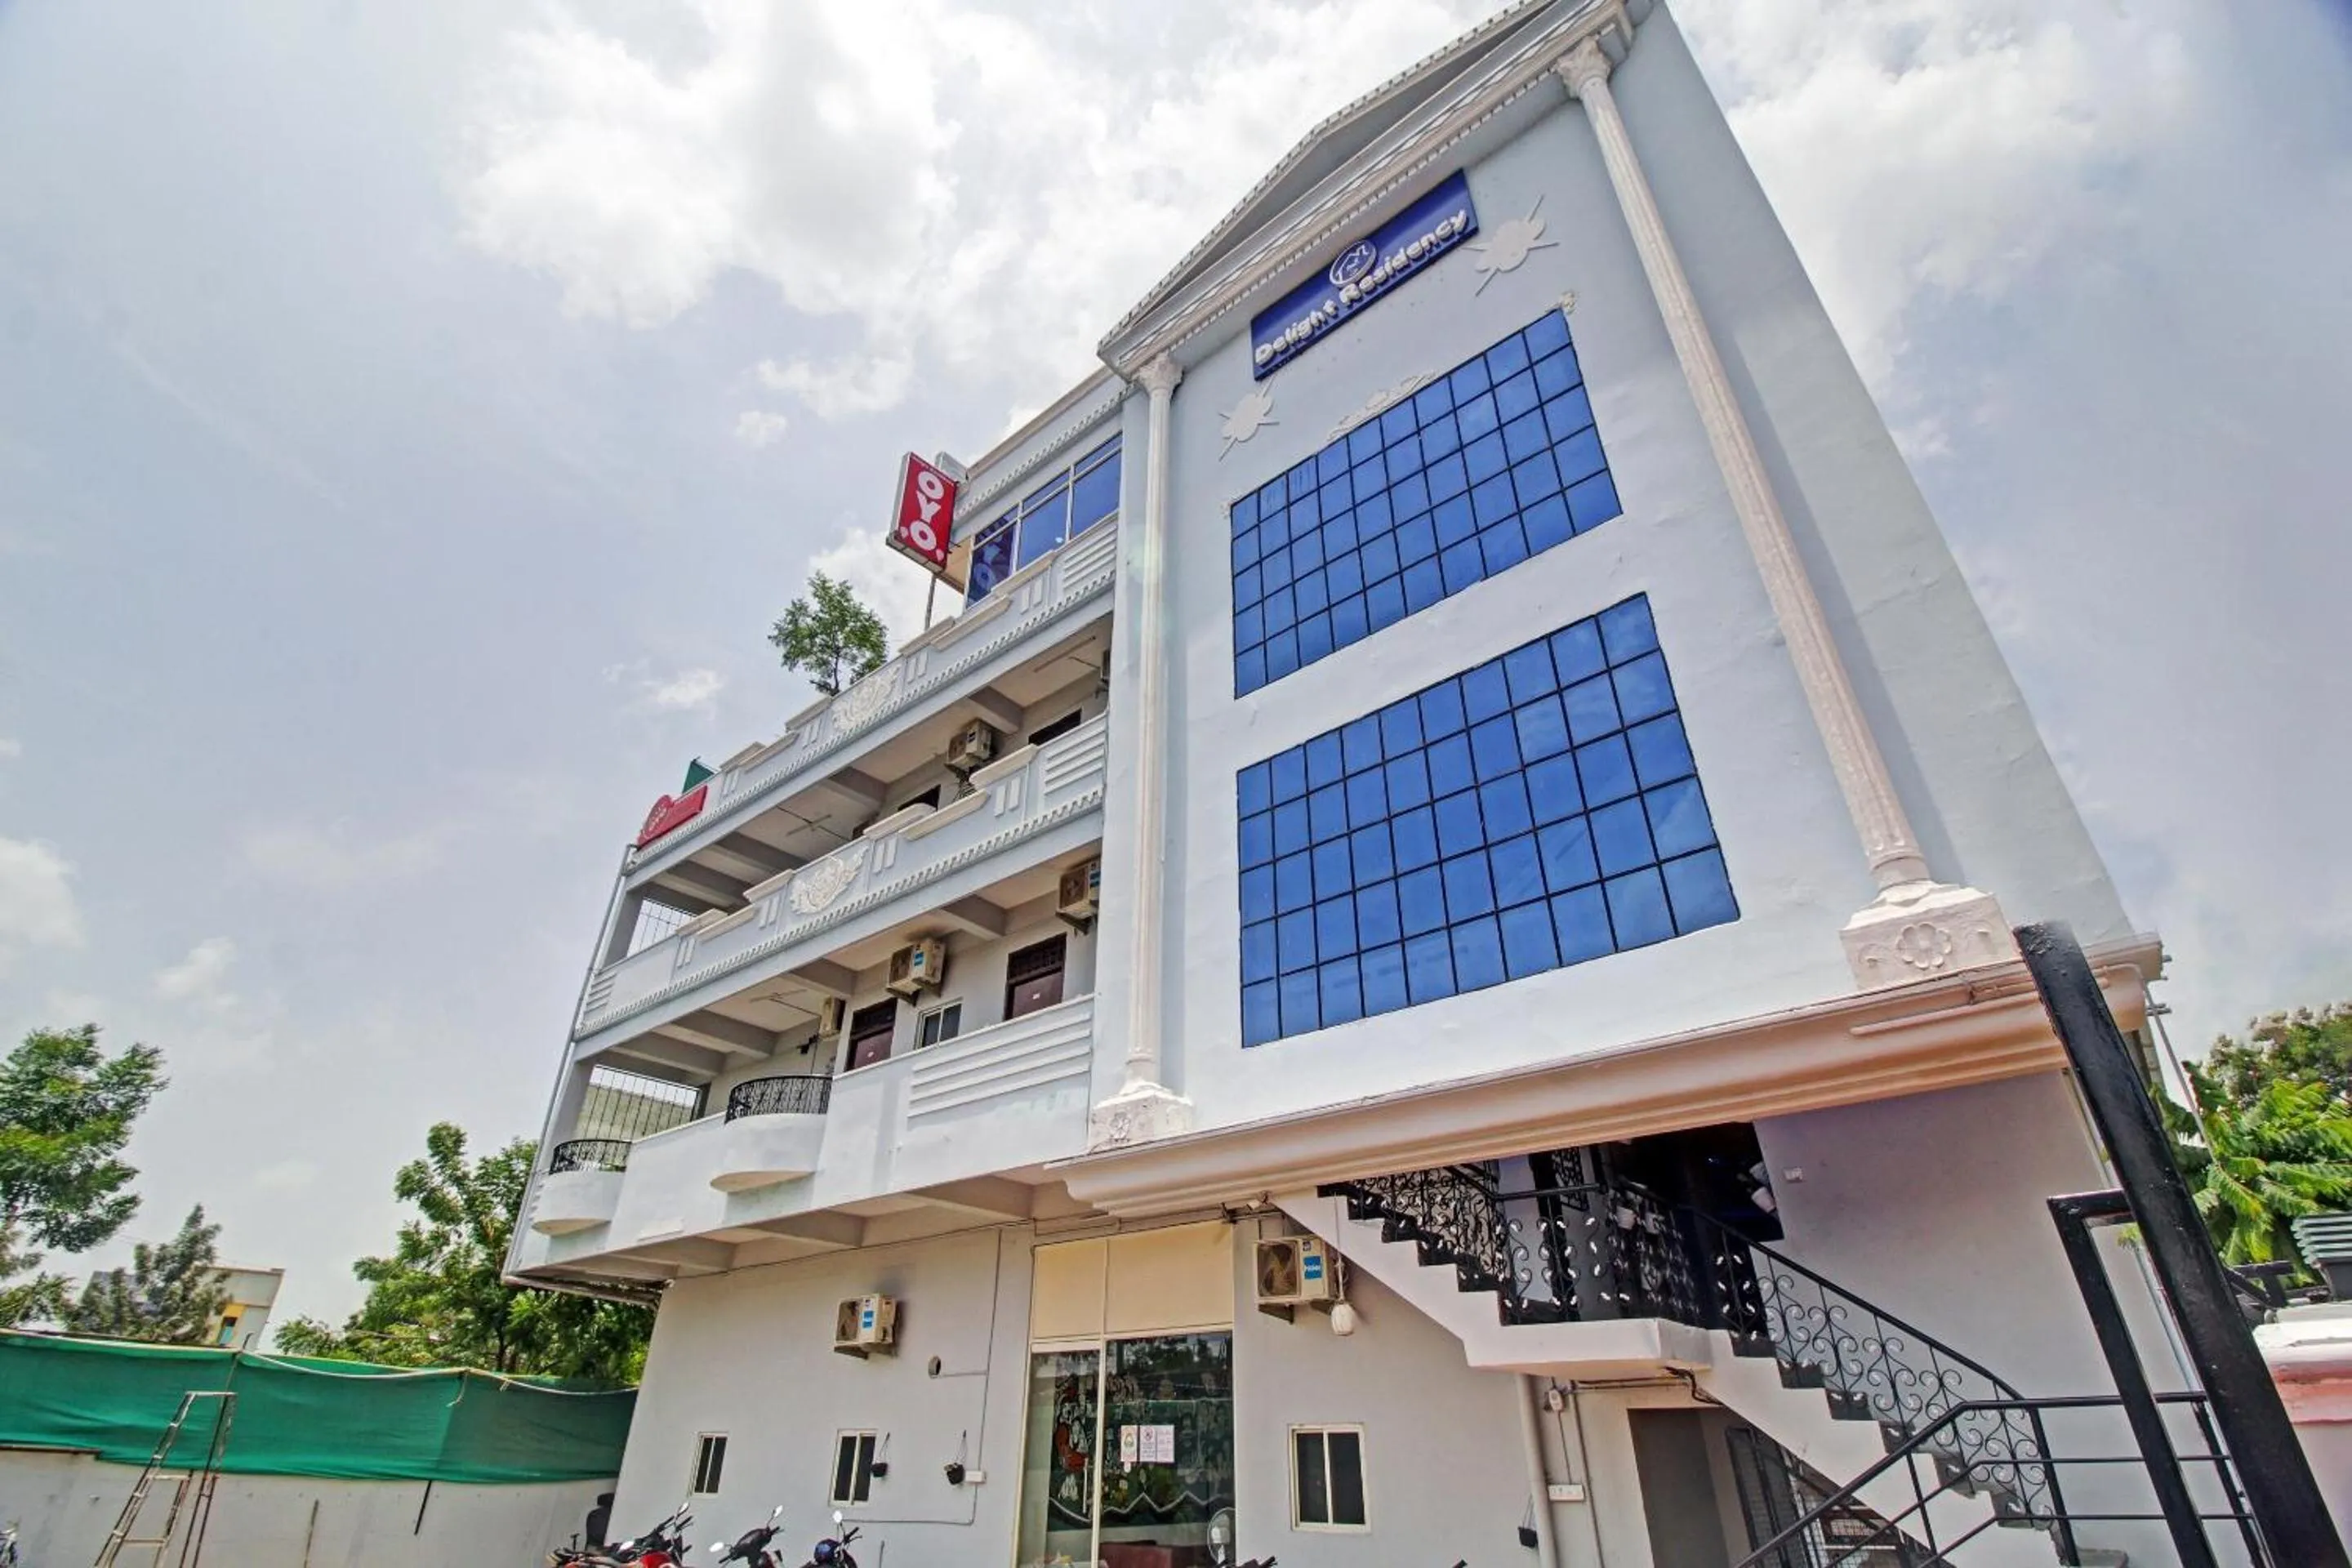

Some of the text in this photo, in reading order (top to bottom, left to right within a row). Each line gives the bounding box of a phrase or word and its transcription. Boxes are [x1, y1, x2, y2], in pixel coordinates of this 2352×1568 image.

[1254, 209, 1468, 365] Delight Residency
[909, 470, 945, 552] OYO
